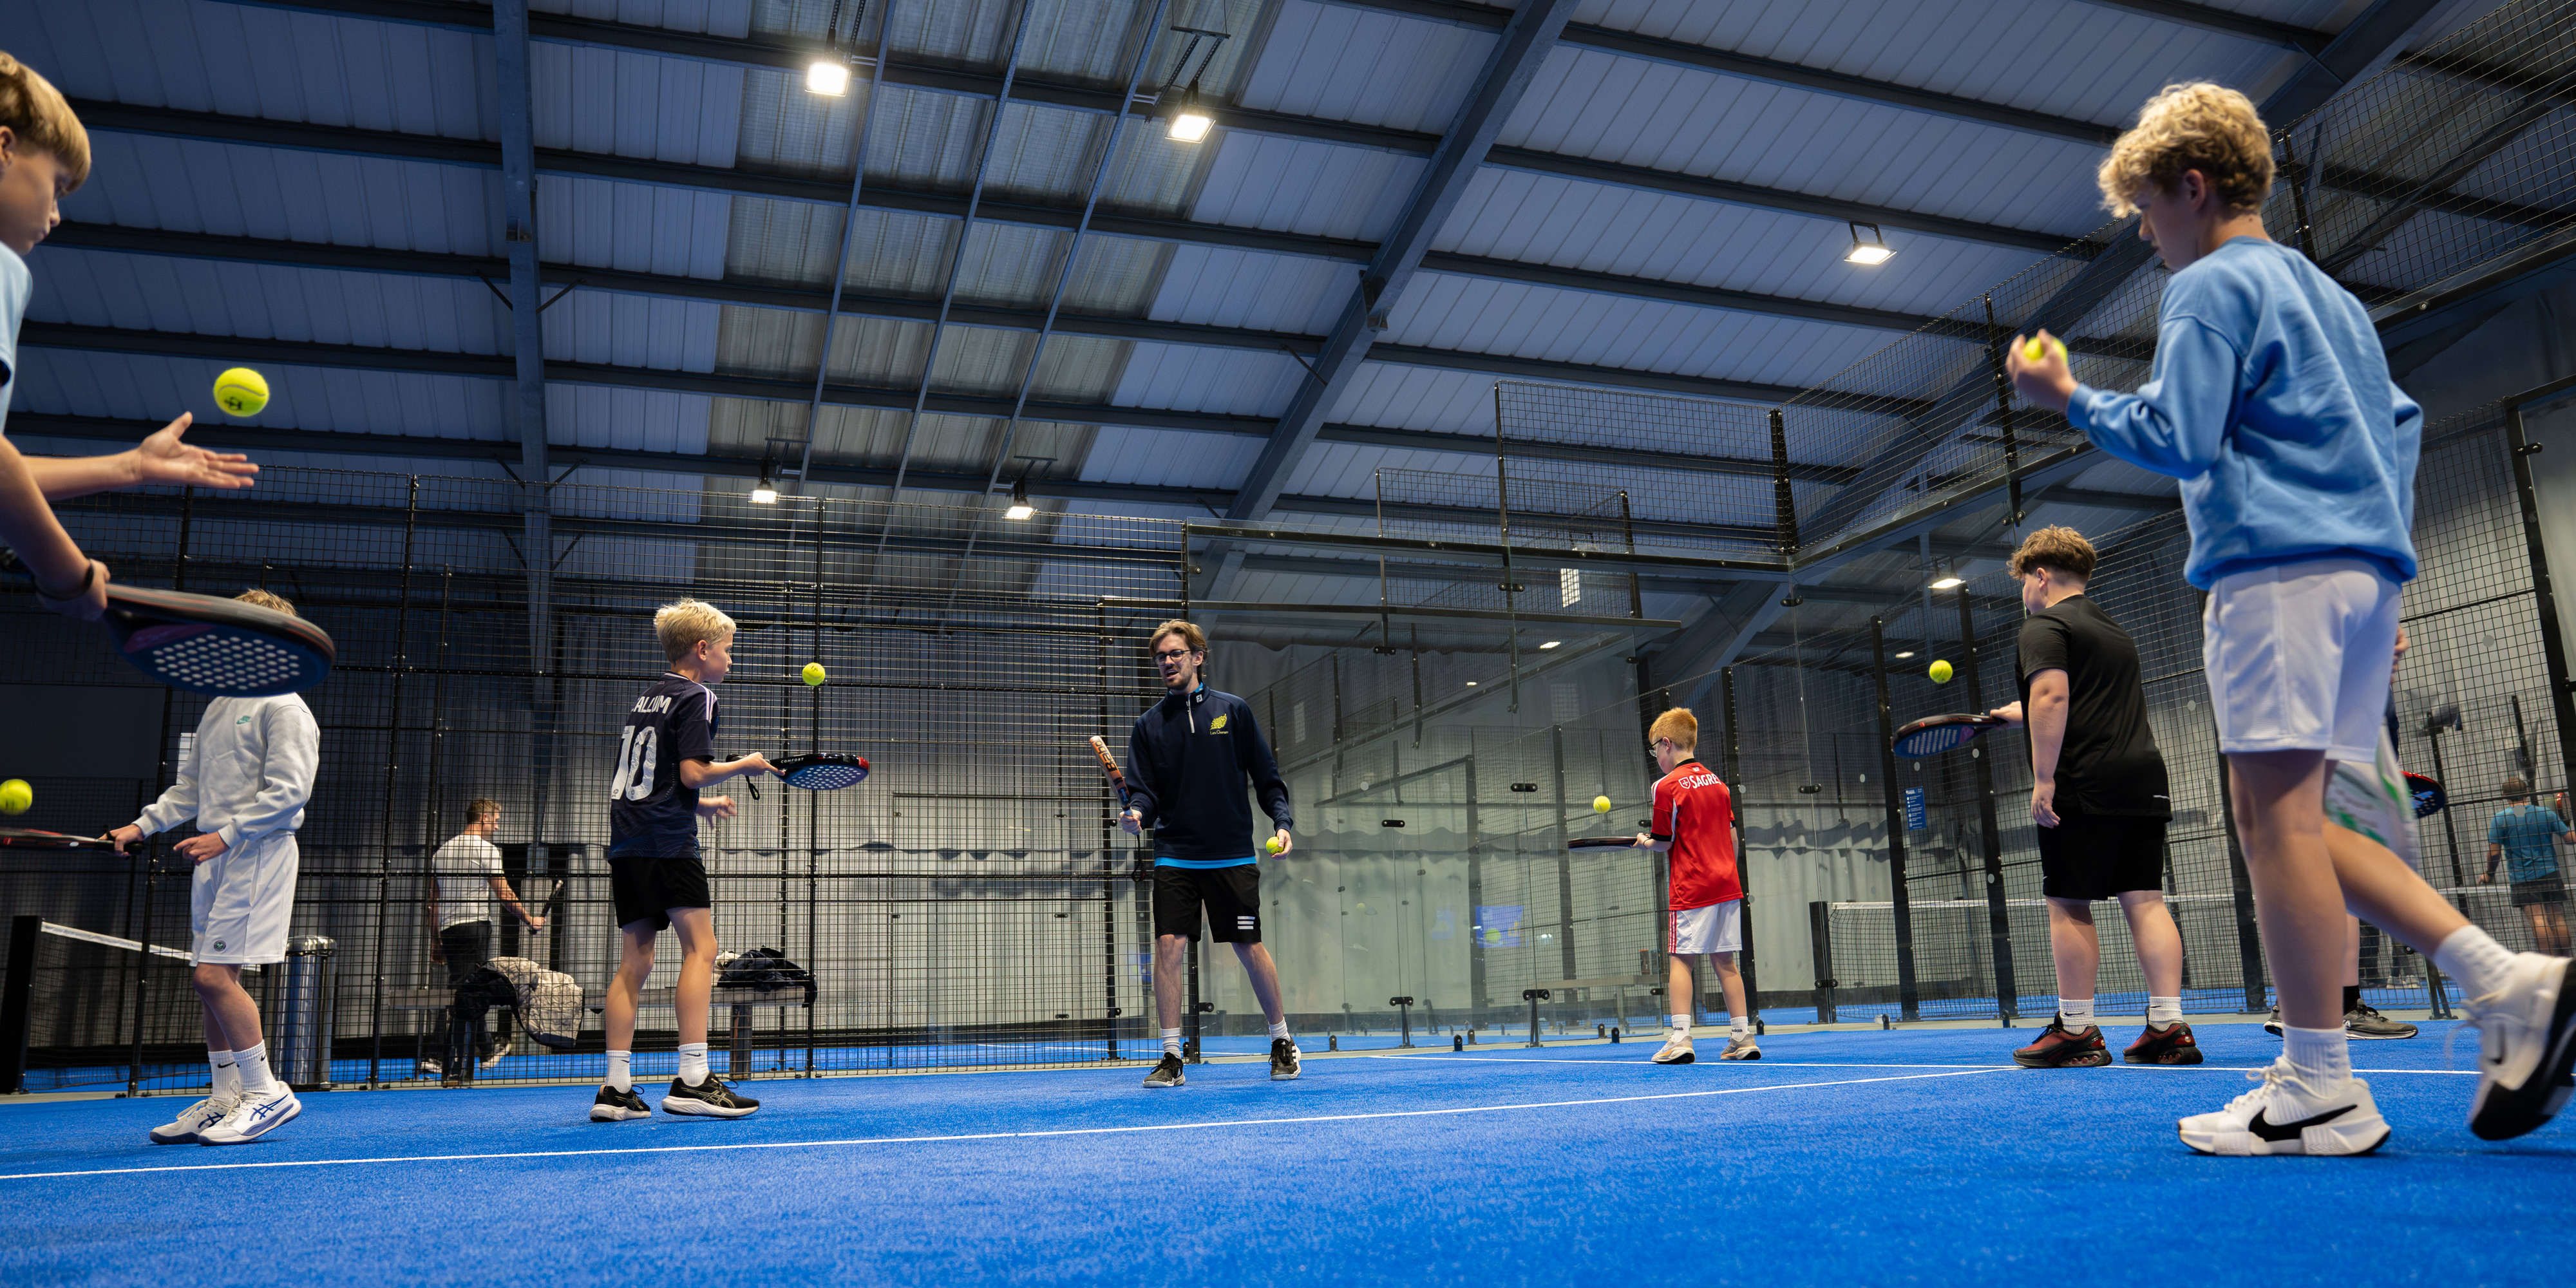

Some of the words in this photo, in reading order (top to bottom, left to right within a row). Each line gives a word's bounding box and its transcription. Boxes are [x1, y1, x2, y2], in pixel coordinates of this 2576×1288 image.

[631, 695, 672, 714] ALLUM
[611, 725, 657, 801] 10
[1092, 739, 1118, 772] Babo
[1689, 773, 1721, 789] SAGRE
